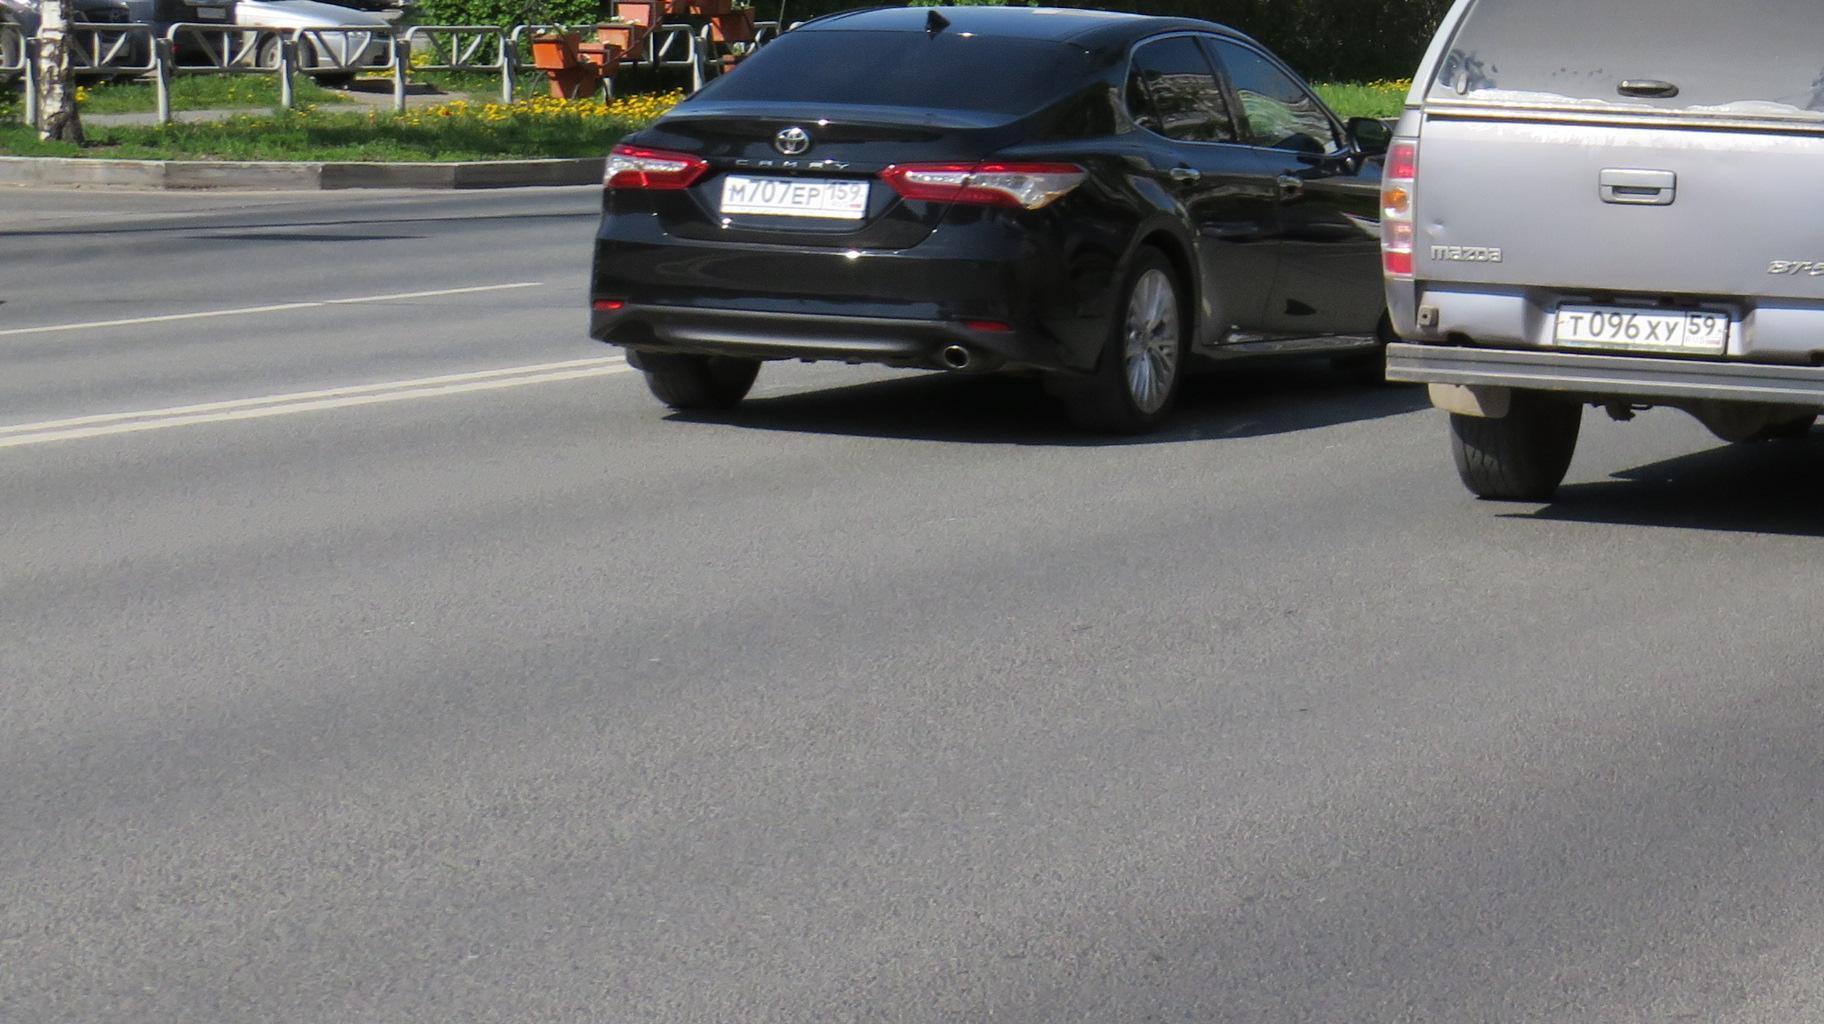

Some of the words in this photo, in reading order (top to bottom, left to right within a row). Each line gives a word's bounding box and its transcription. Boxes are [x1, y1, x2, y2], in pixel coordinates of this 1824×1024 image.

[735, 159, 849, 169] CAMRY
[729, 180, 821, 205] М707ЕР
[827, 184, 862, 201] 159
[1687, 314, 1716, 336] 59
